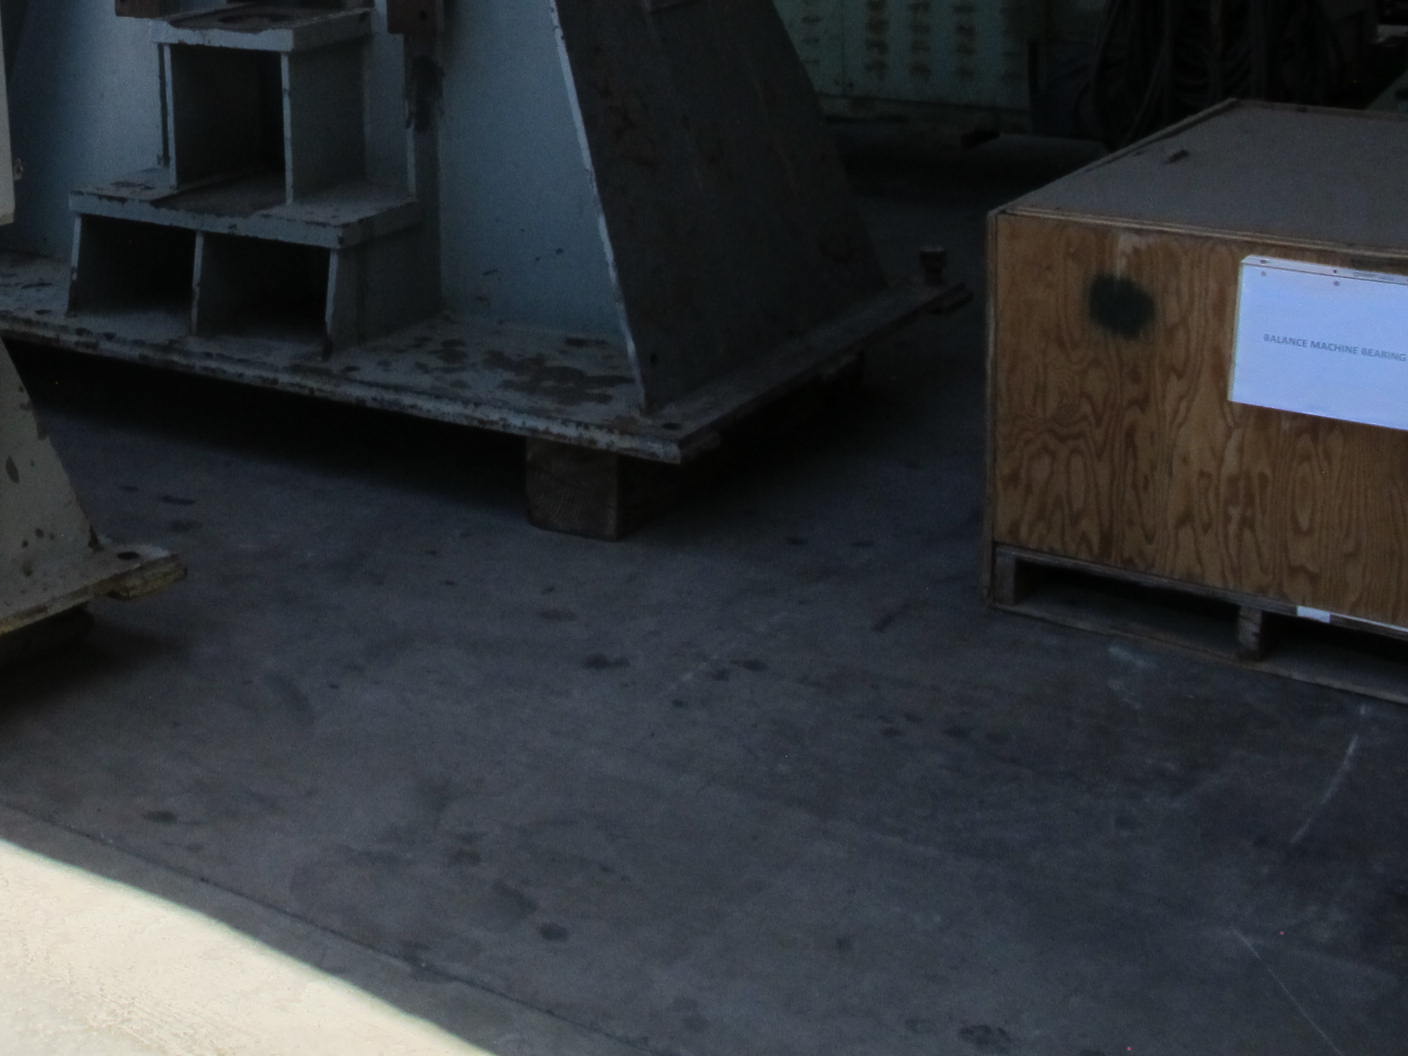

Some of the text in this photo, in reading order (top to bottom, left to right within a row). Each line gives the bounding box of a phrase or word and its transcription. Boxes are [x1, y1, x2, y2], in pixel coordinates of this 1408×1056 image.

[1263, 333, 1407, 362] BALANCE MACHINE BEARING
